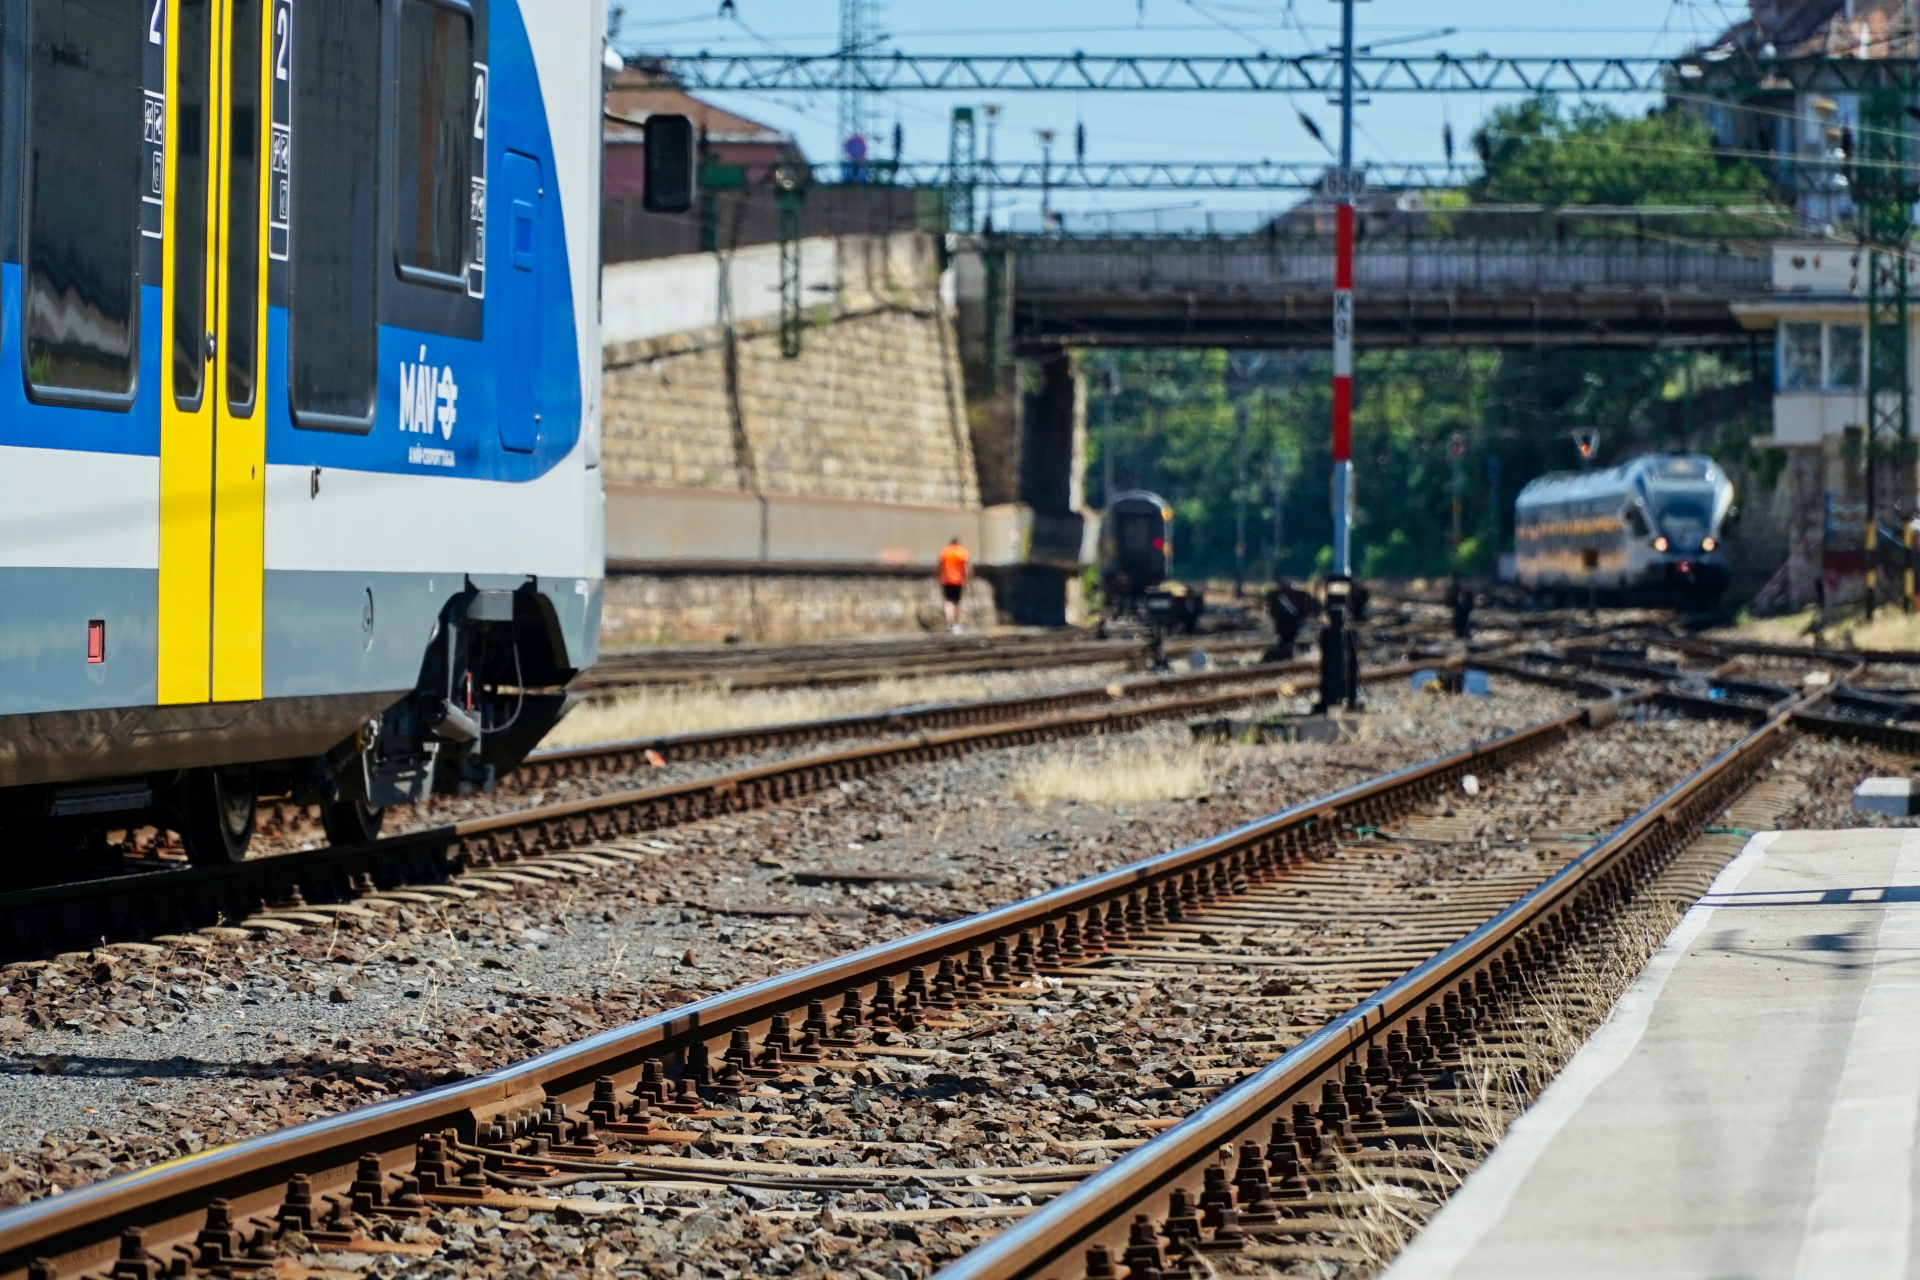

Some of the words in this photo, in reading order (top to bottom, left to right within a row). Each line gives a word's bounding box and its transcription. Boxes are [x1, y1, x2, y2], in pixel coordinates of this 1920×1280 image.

[276, 7, 288, 81] 2
[473, 74, 484, 140] 2
[399, 344, 439, 435] MÁV
